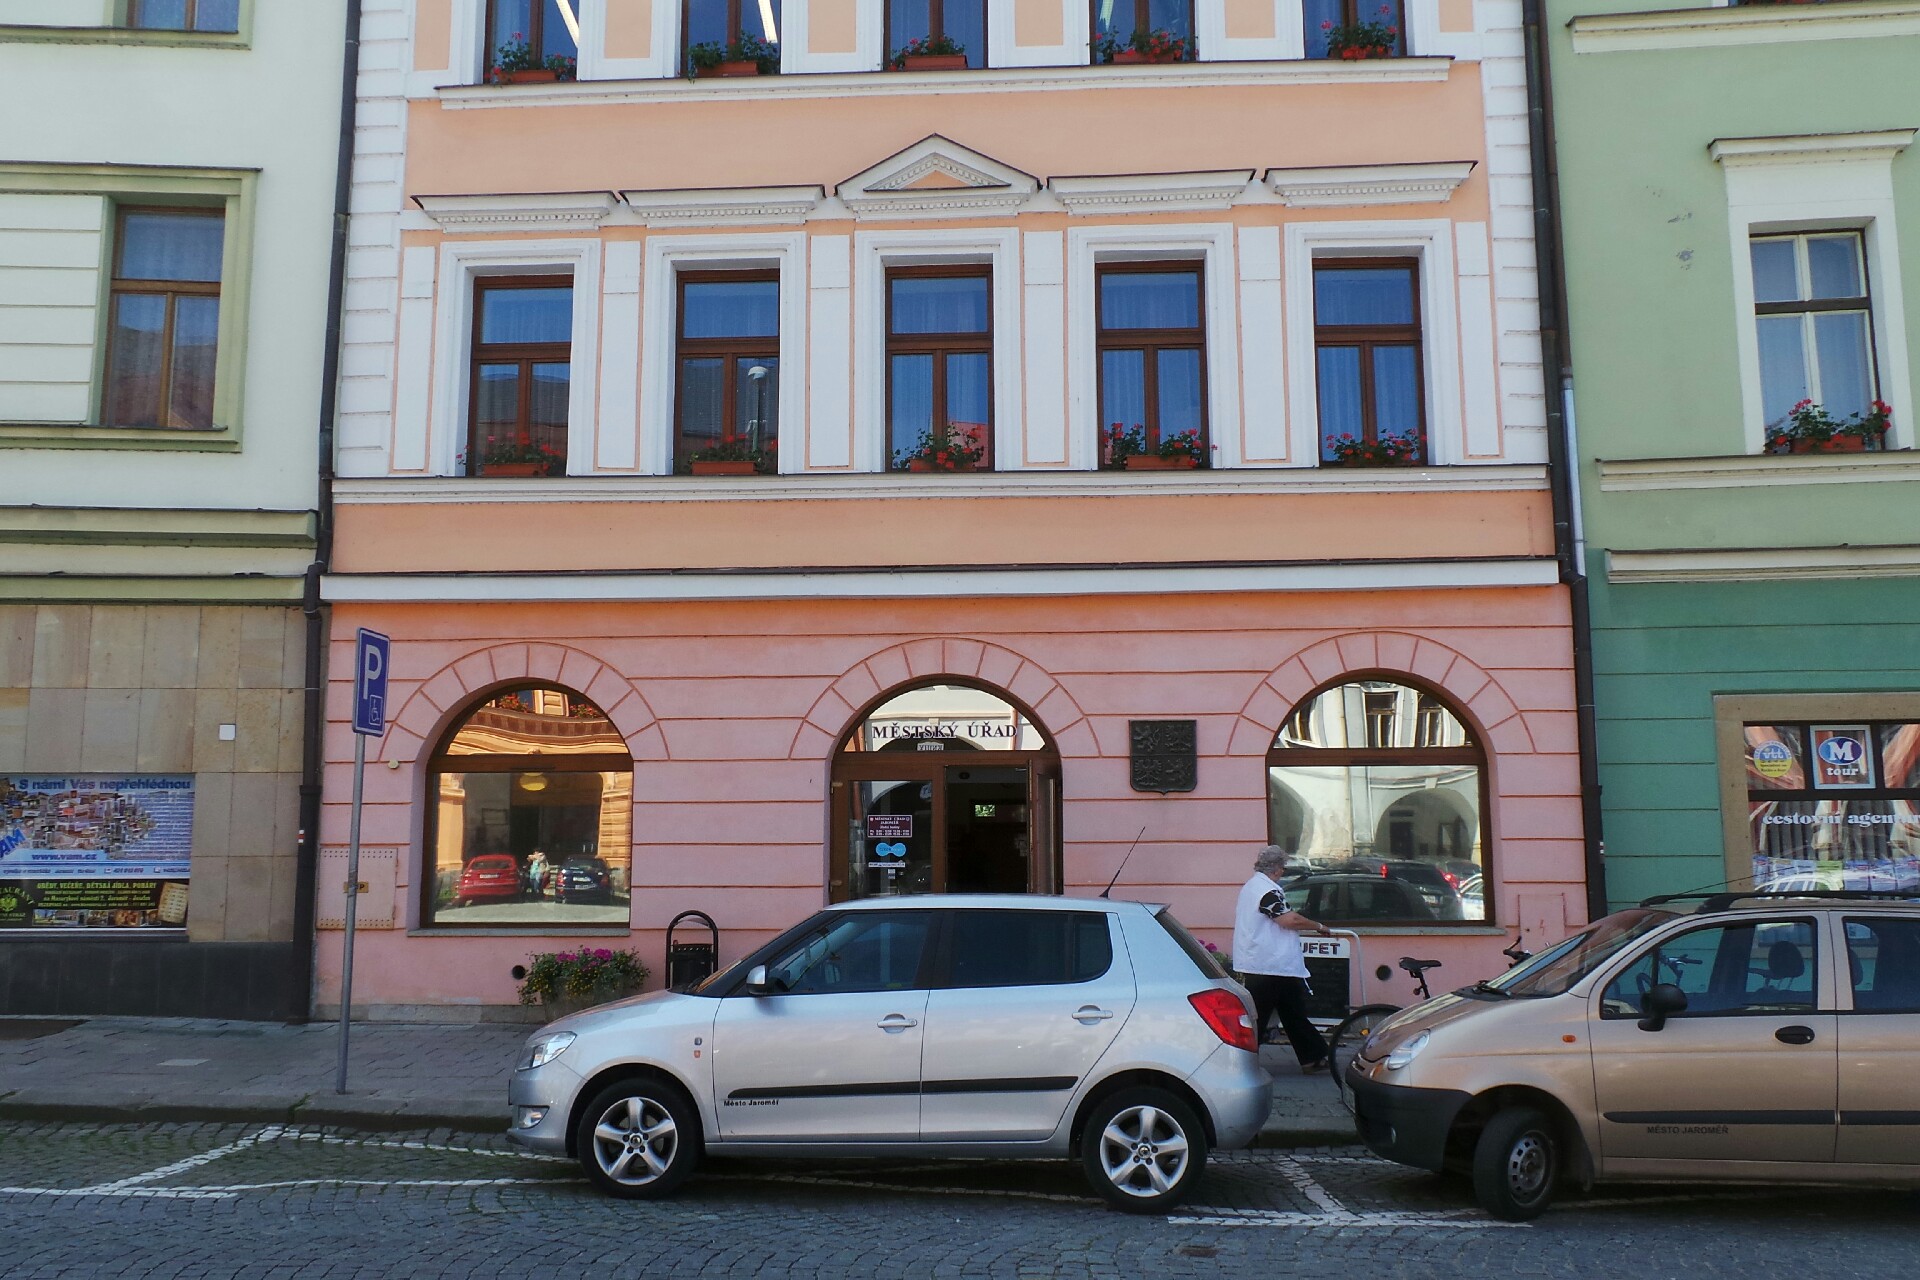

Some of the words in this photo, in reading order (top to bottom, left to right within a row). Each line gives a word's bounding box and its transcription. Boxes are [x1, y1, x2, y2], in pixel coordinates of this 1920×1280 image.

[363, 644, 382, 700] P
[872, 722, 958, 739] MĚSTSKÝ
[967, 721, 1017, 738] ÚŘAD
[1828, 741, 1854, 761] M
[1826, 767, 1859, 776] tour
[18, 779, 28, 790] S
[32, 778, 66, 790] námi
[70, 778, 96, 790] Vás
[100, 777, 191, 792] nepřehlédnou
[1762, 811, 1841, 825] cestovní
[1300, 942, 1341, 956] UFET
[1647, 1124, 1680, 1134] MĚSTO
[1682, 1124, 1729, 1134] JAROMĚŘ
